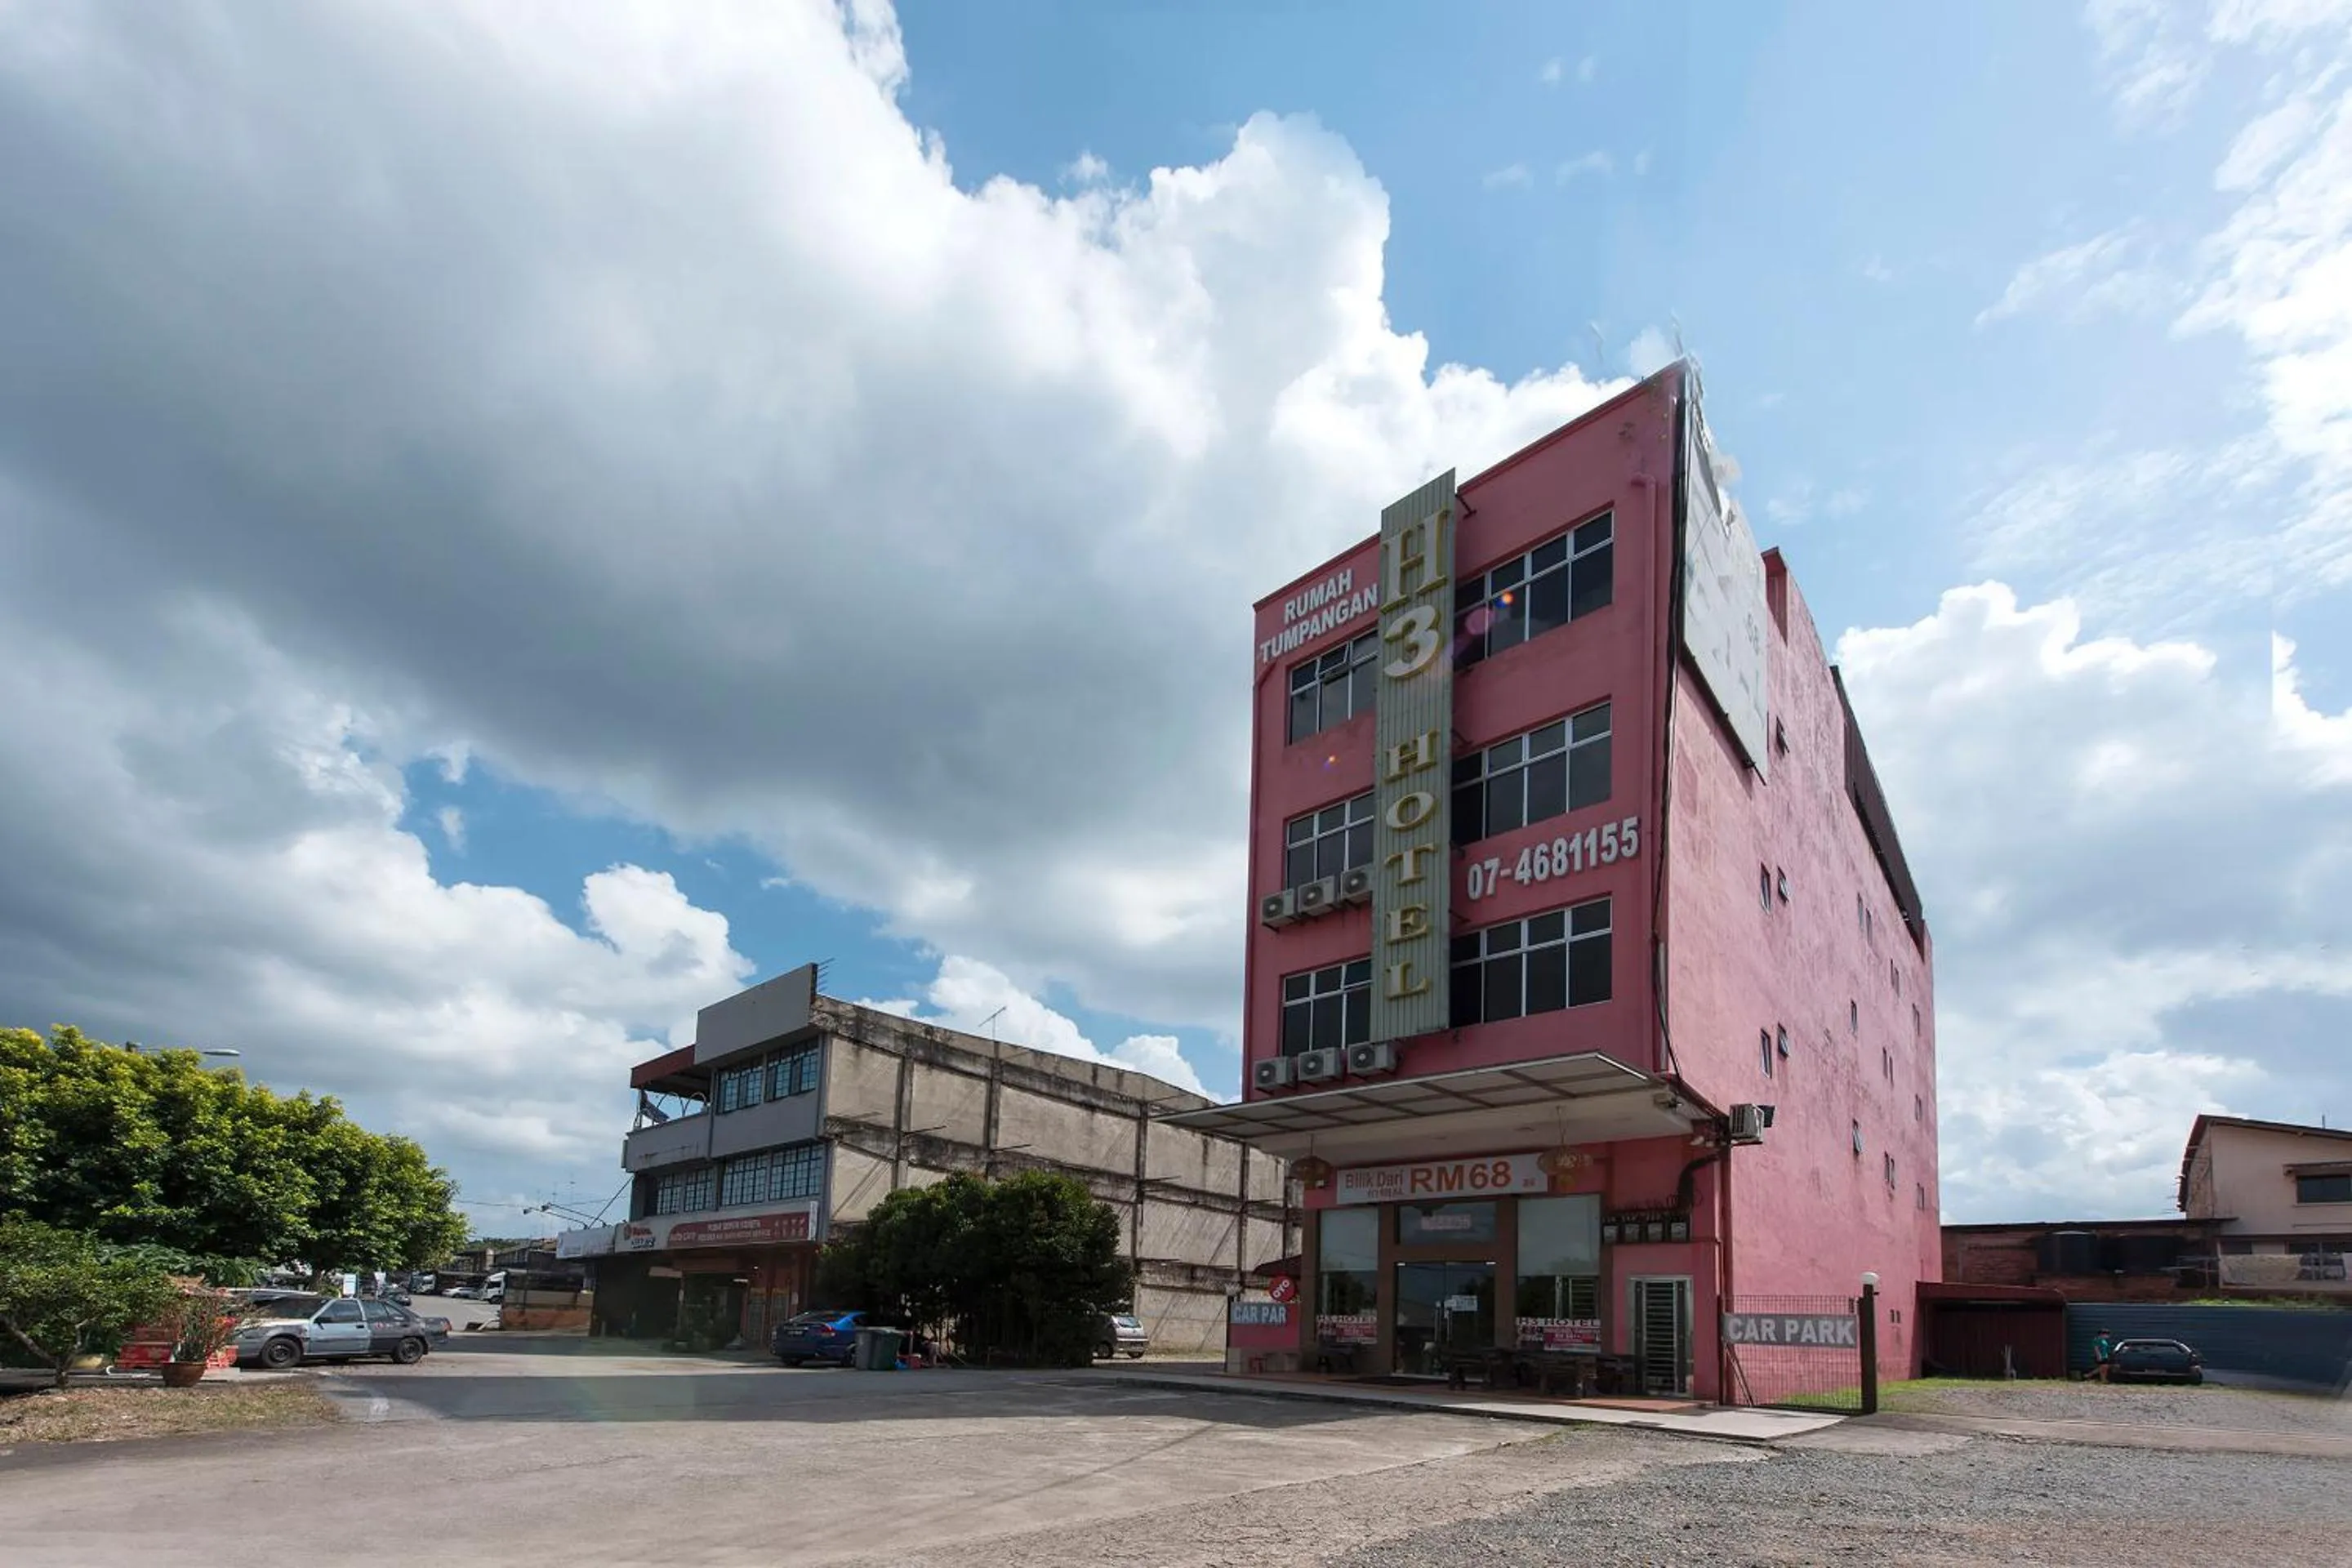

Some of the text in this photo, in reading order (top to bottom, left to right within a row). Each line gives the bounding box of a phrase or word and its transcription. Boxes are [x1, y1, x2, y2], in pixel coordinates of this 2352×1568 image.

[1284, 568, 1352, 625] RUMAH
[1259, 583, 1378, 663] TUMPANGAN
[1384, 729, 1439, 1000] HOTEL
[1468, 816, 1639, 900] 07-4681155
[1345, 1170, 1373, 1189] Bilik
[1377, 1167, 1403, 1185] Dari
[1410, 1160, 1511, 1194] RM68
[1272, 1278, 1290, 1298] OYO
[1233, 1306, 1257, 1323] CAR
[1727, 1317, 1855, 1345] CAR PARK
